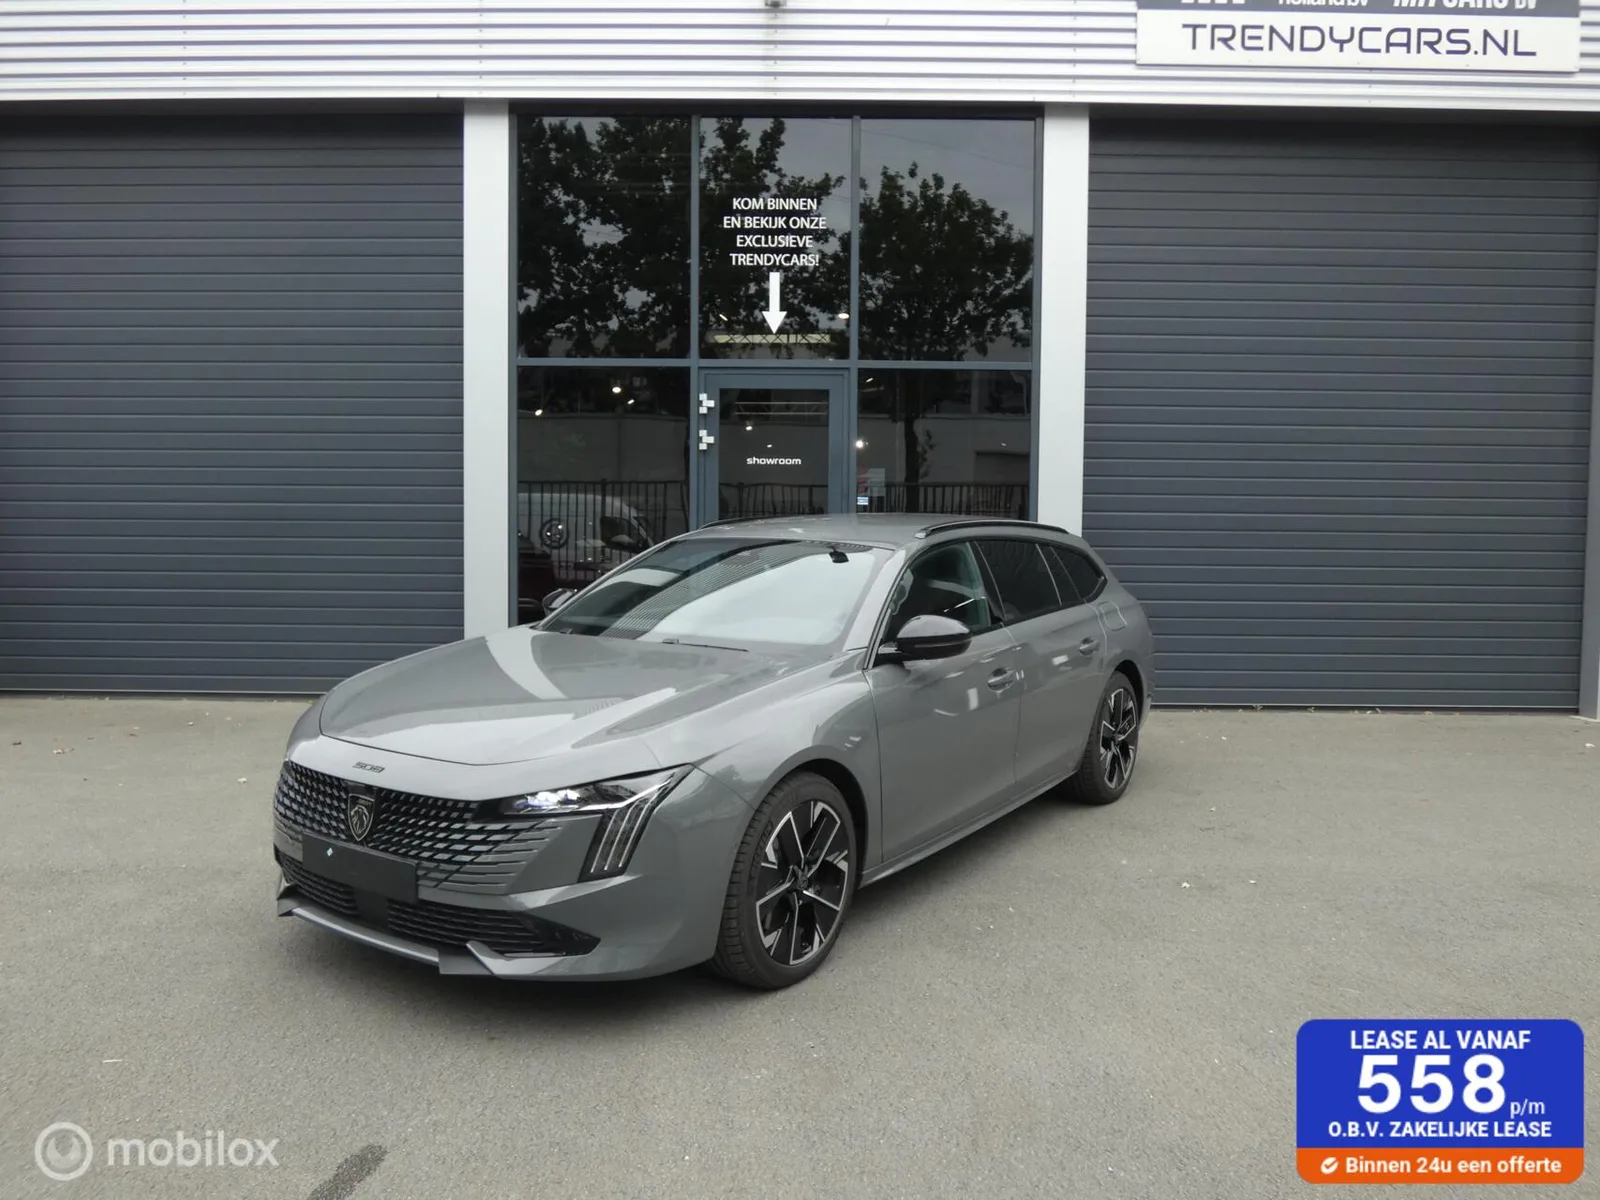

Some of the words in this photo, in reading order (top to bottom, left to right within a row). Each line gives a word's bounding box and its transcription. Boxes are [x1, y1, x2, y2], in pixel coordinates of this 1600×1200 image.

[1182, 23, 1537, 57] TRENDYCARS.NL
[732, 197, 764, 210] KOM
[767, 197, 817, 210] BINNEN
[723, 216, 741, 229] EN
[744, 216, 787, 229] BEKIJK
[789, 216, 827, 230] ONZE
[736, 234, 813, 248] EXCLUSIEVE
[729, 253, 820, 267] TRENDYCARS!
[746, 456, 801, 465] showroom
[352, 761, 385, 772] 508
